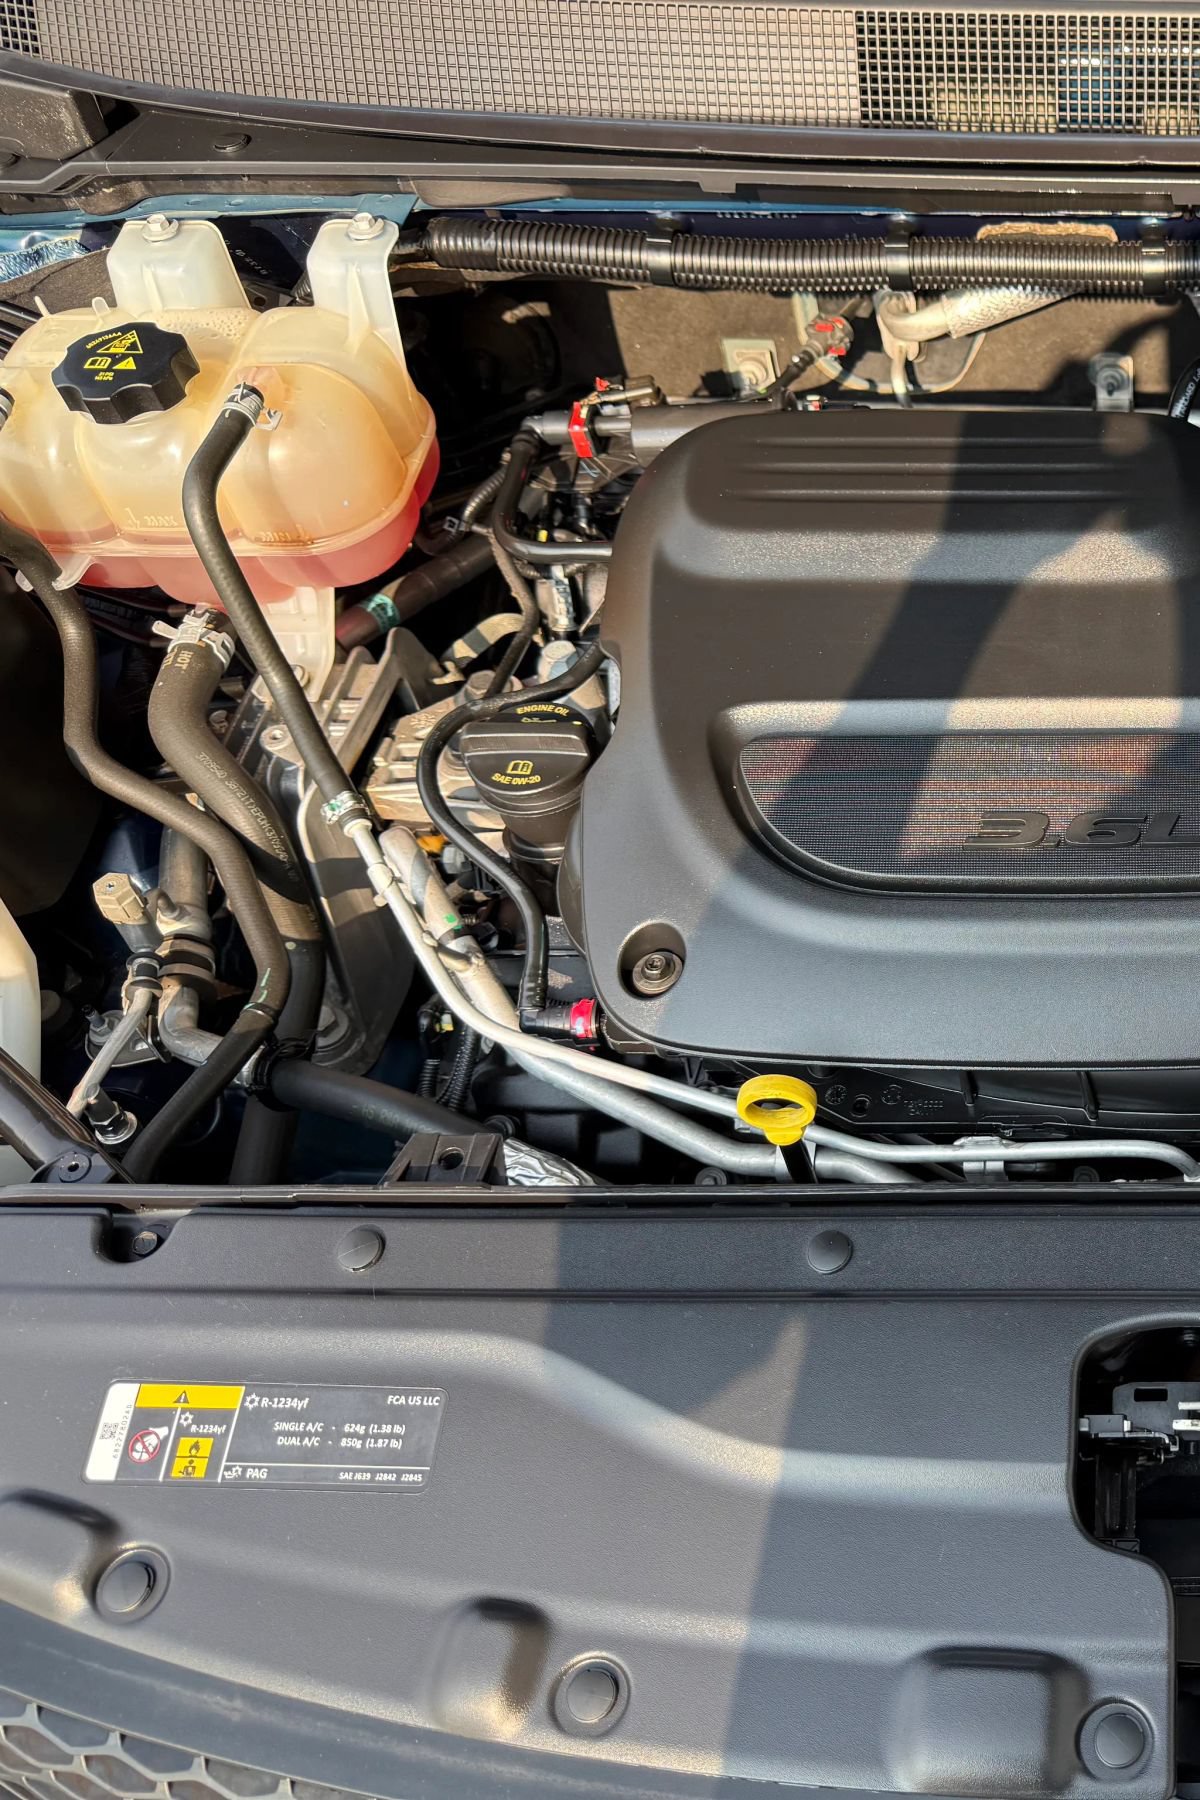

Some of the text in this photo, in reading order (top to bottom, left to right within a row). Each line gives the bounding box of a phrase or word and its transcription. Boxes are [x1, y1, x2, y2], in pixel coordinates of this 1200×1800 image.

[174, 650, 194, 671] HOT
[516, 704, 569, 716] ENGINE OIL
[492, 772, 541, 785] SAE 0W-20
[261, 1395, 440, 1409] R-1234yf FCA US LLC
[190, 1424, 227, 1435] R-1234yf
[274, 1422, 305, 1431] SINGLE
[306, 1422, 324, 1432] A/C
[344, 1424, 366, 1434] 624g
[369, 1424, 393, 1435] (1.38
[393, 1424, 406, 1435] lb)
[277, 1437, 301, 1446] DUAL
[302, 1437, 320, 1446] A/C
[340, 1438, 362, 1449] 850g
[366, 1438, 389, 1449] (1.87
[390, 1438, 403, 1450] lb)
[246, 1468, 423, 1482] PAG SAE J639 J2842 J2845
